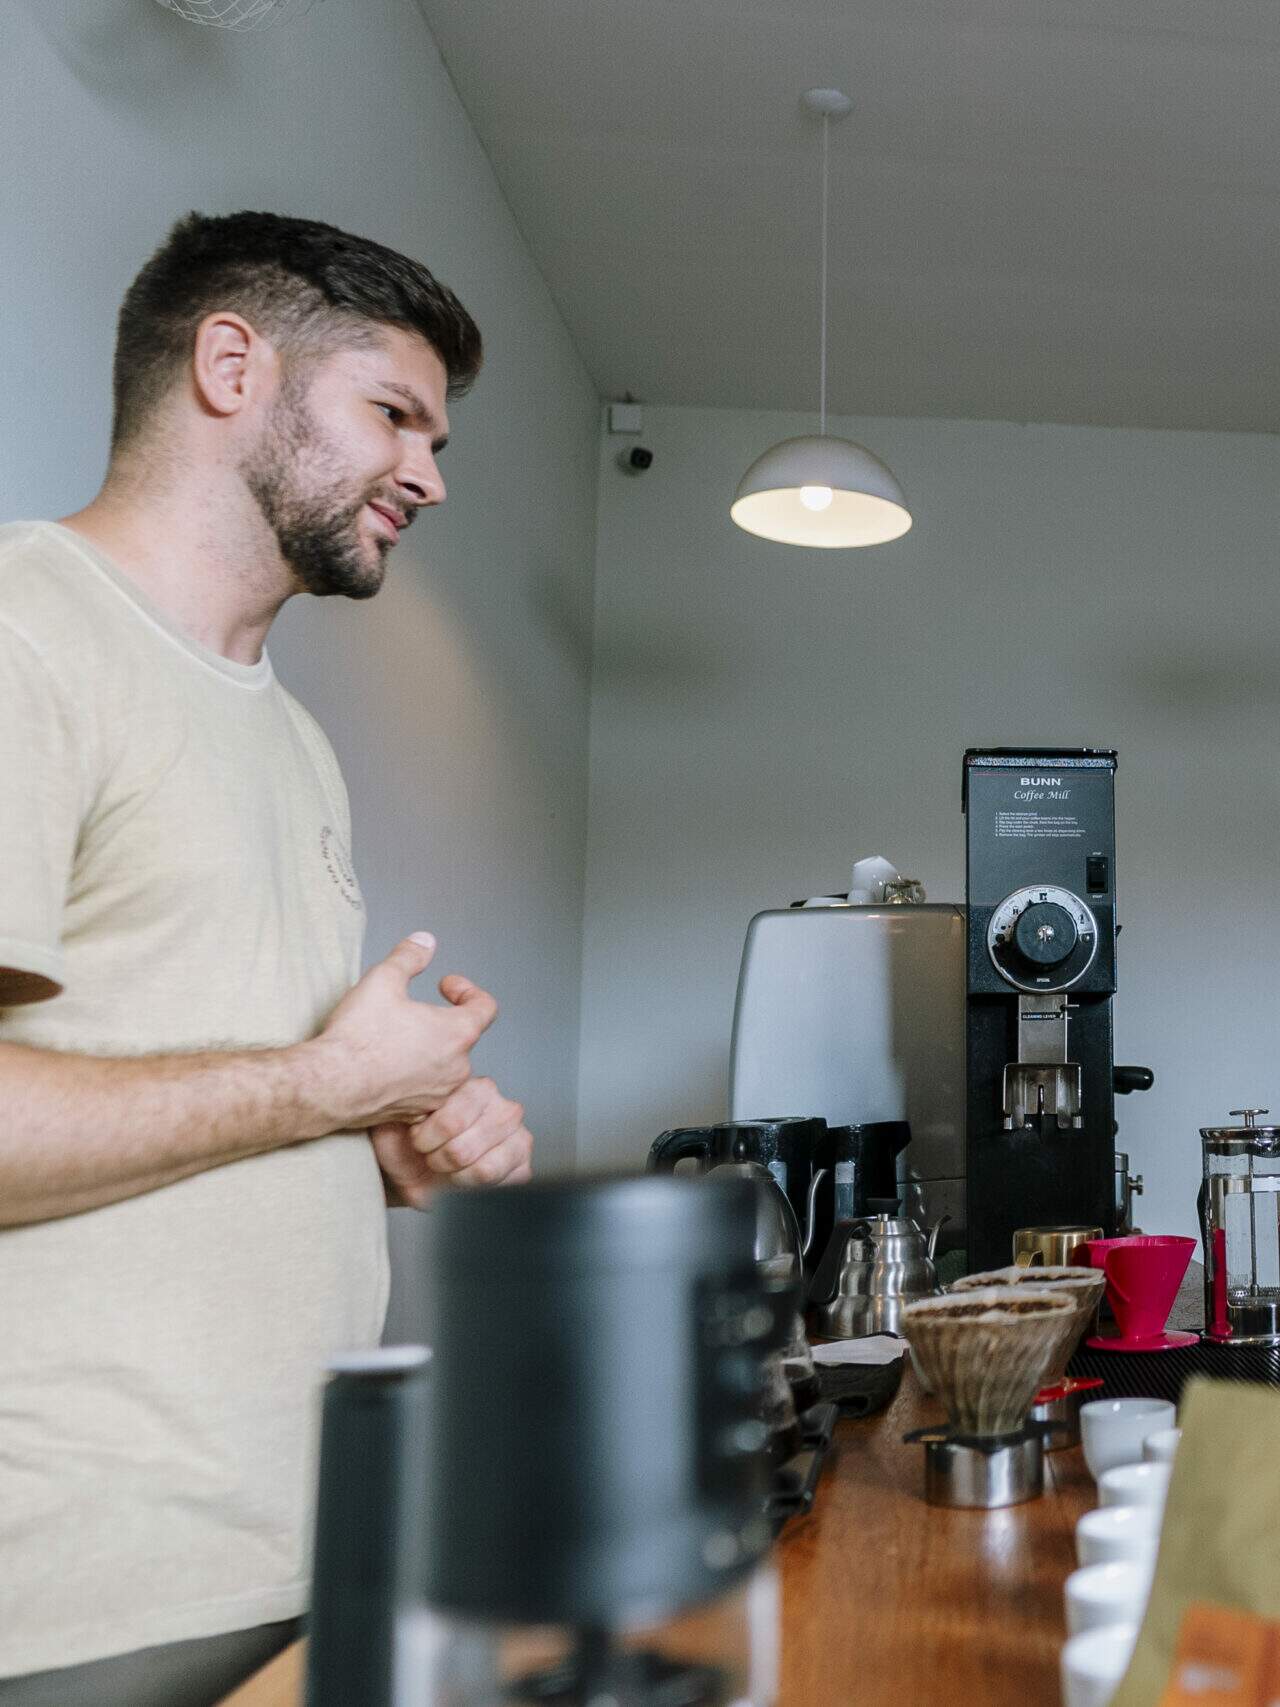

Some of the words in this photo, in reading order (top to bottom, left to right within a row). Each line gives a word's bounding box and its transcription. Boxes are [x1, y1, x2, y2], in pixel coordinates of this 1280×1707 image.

[1020, 777, 1061, 786] BUNN
[1014, 789, 1044, 802] Coffee
[1046, 789, 1072, 800] Mill
